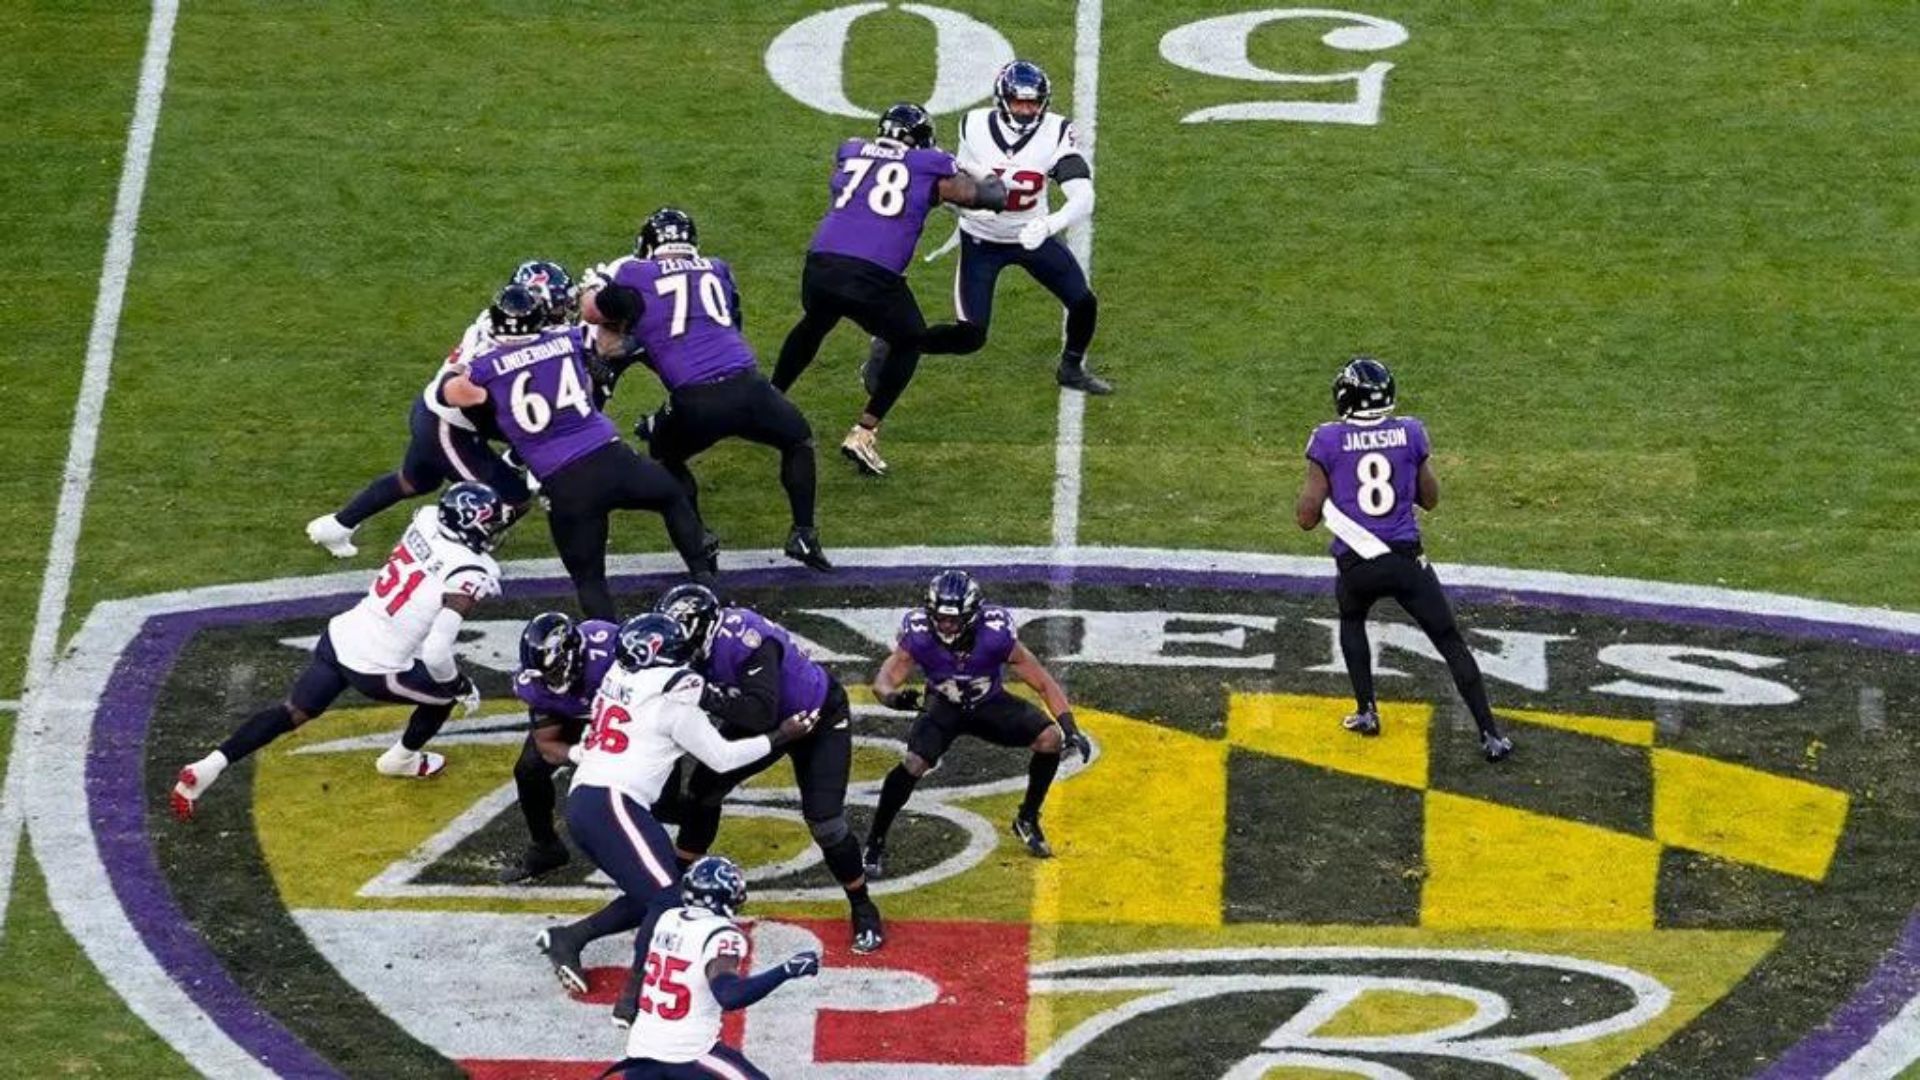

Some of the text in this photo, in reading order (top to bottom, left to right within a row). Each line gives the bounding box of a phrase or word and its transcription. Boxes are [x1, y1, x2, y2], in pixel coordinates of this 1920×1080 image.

[834, 158, 910, 217] 78
[992, 168, 1045, 212] 2
[655, 272, 731, 337] 70
[492, 336, 575, 376] LINDERBAUM
[510, 356, 592, 434] 64
[1342, 427, 1407, 451] JACKSON
[1357, 452, 1395, 516] 8
[374, 543, 426, 618] 51
[589, 630, 609, 661] 76
[639, 952, 692, 1020] 25
